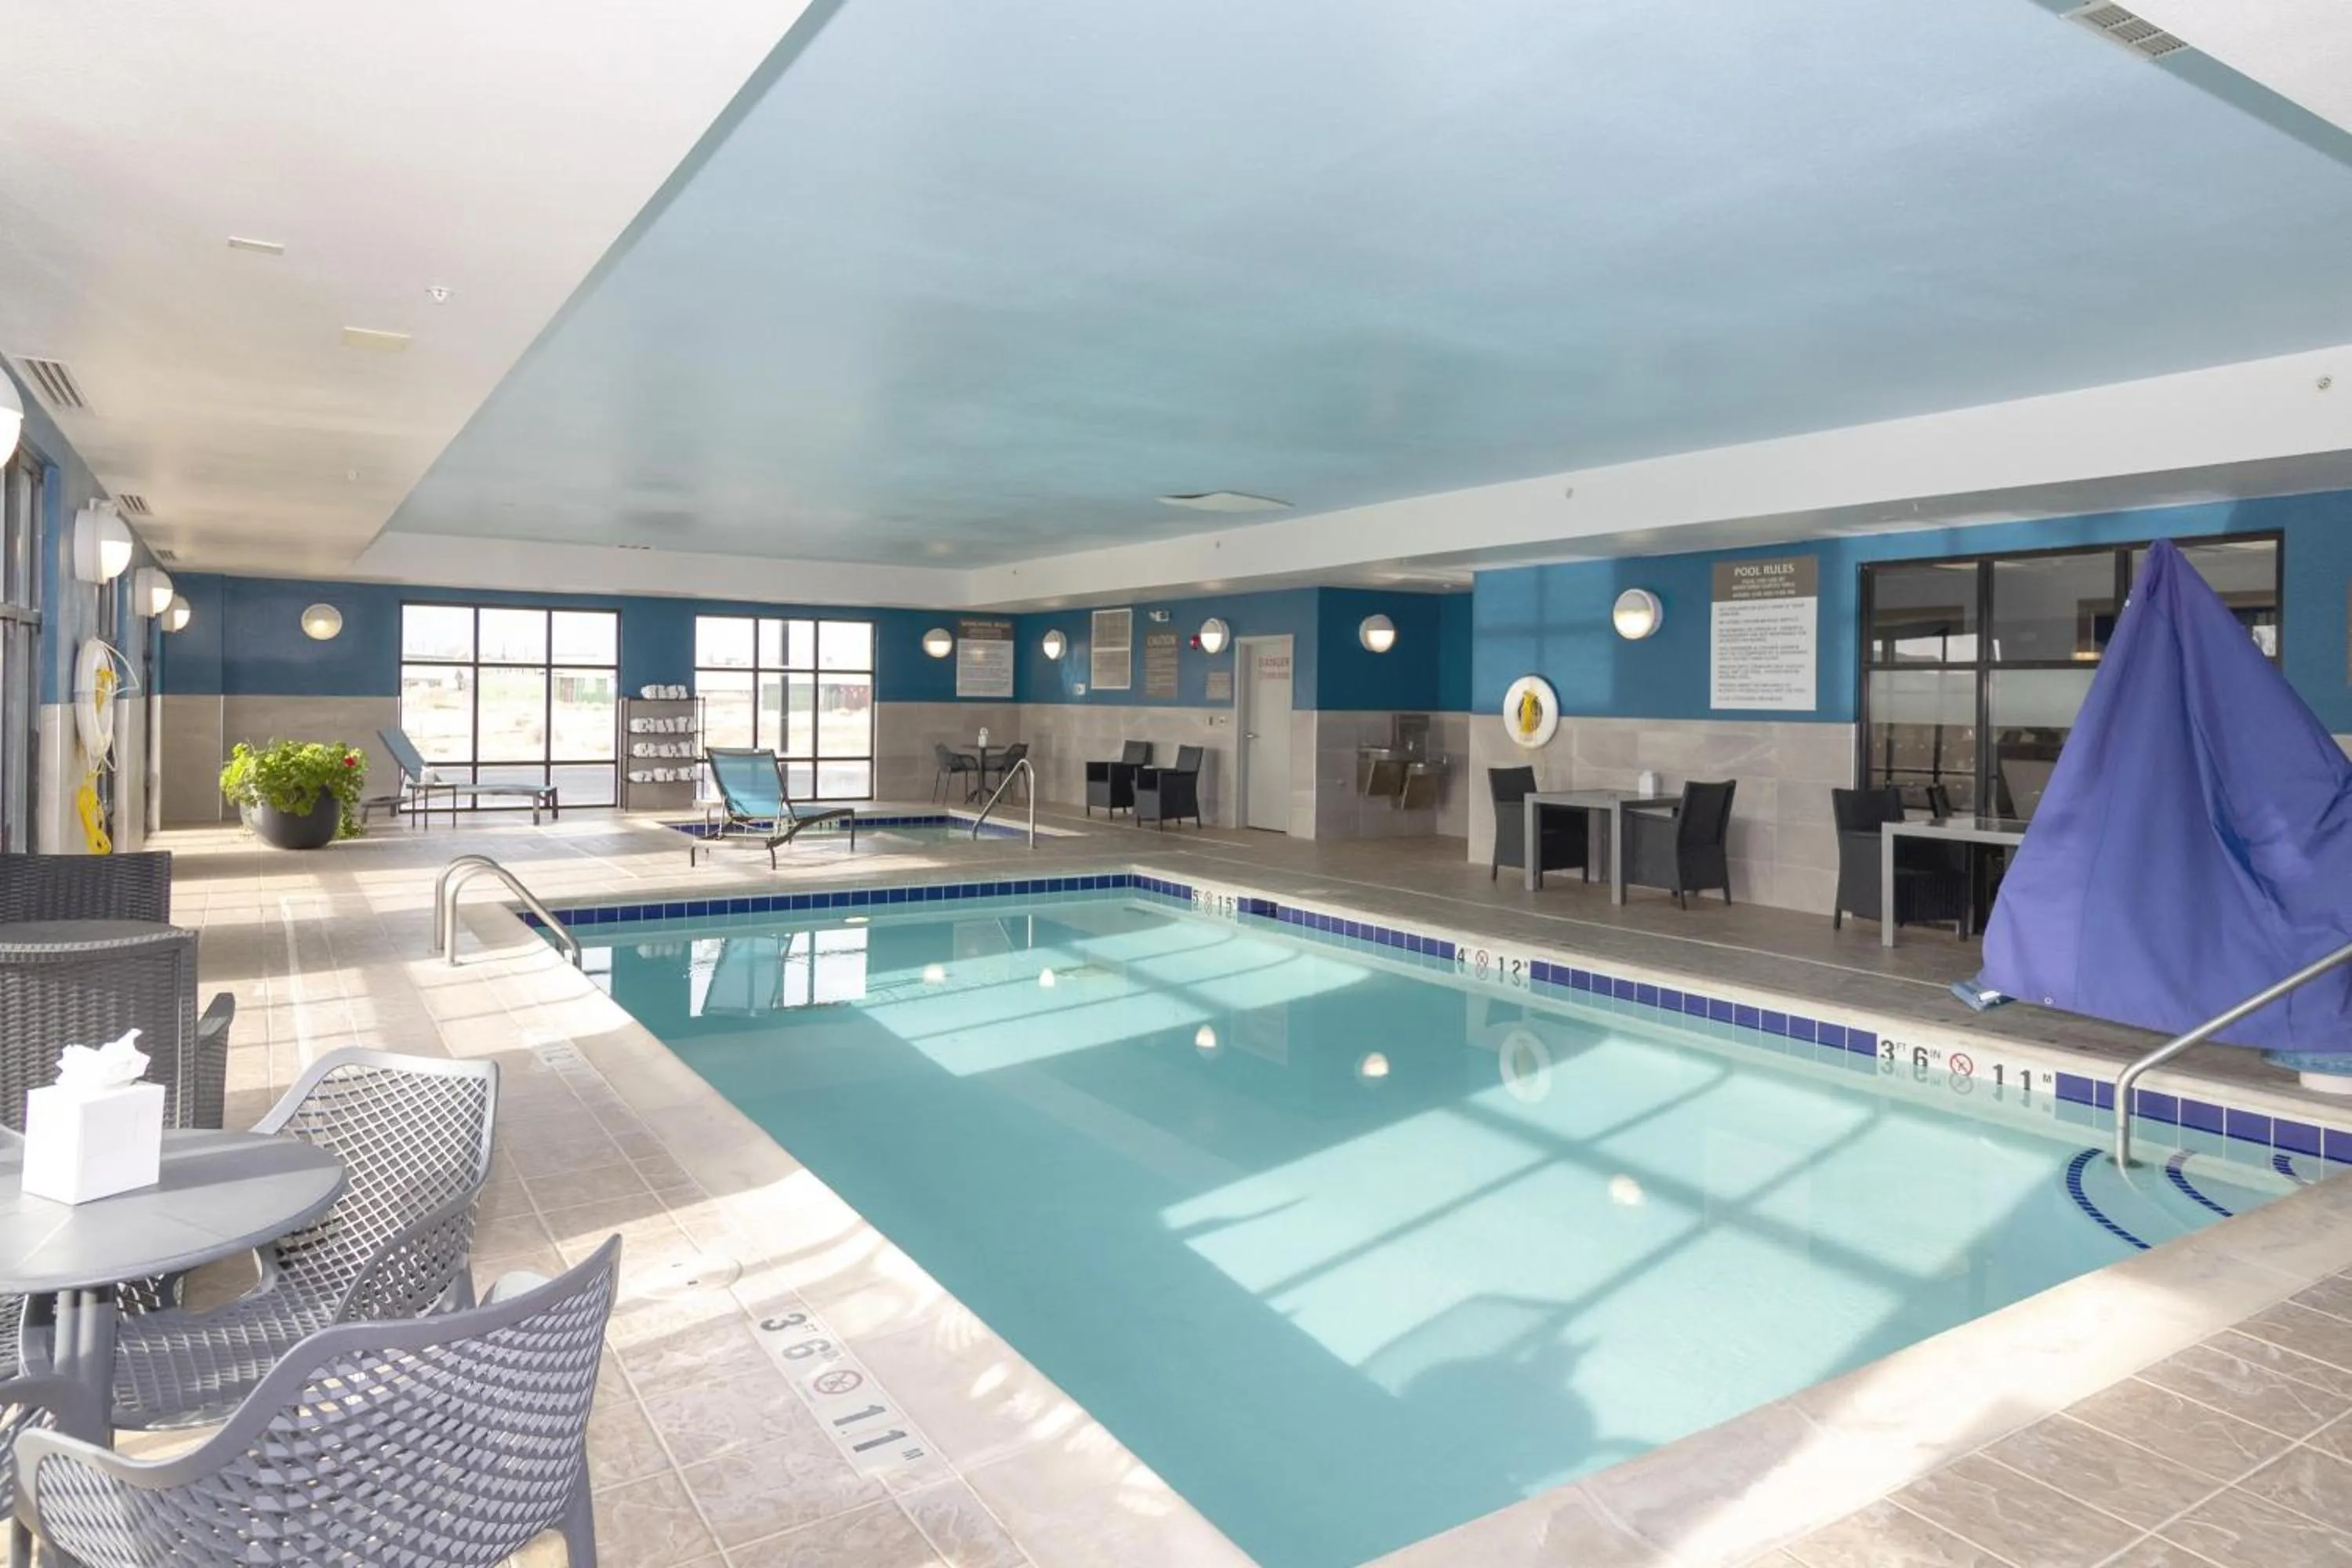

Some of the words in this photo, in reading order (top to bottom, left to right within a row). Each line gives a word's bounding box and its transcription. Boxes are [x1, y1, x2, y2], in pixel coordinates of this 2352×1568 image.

[1733, 566, 1761, 577] POOL
[1763, 564, 1795, 575] RULES
[1457, 947, 1465, 962] 4
[1880, 1039, 1895, 1061] 3
[1912, 1046, 1929, 1067] 6
[2042, 1073, 2053, 1084] M
[760, 1312, 807, 1332] 3
[782, 1338, 832, 1360] 6
